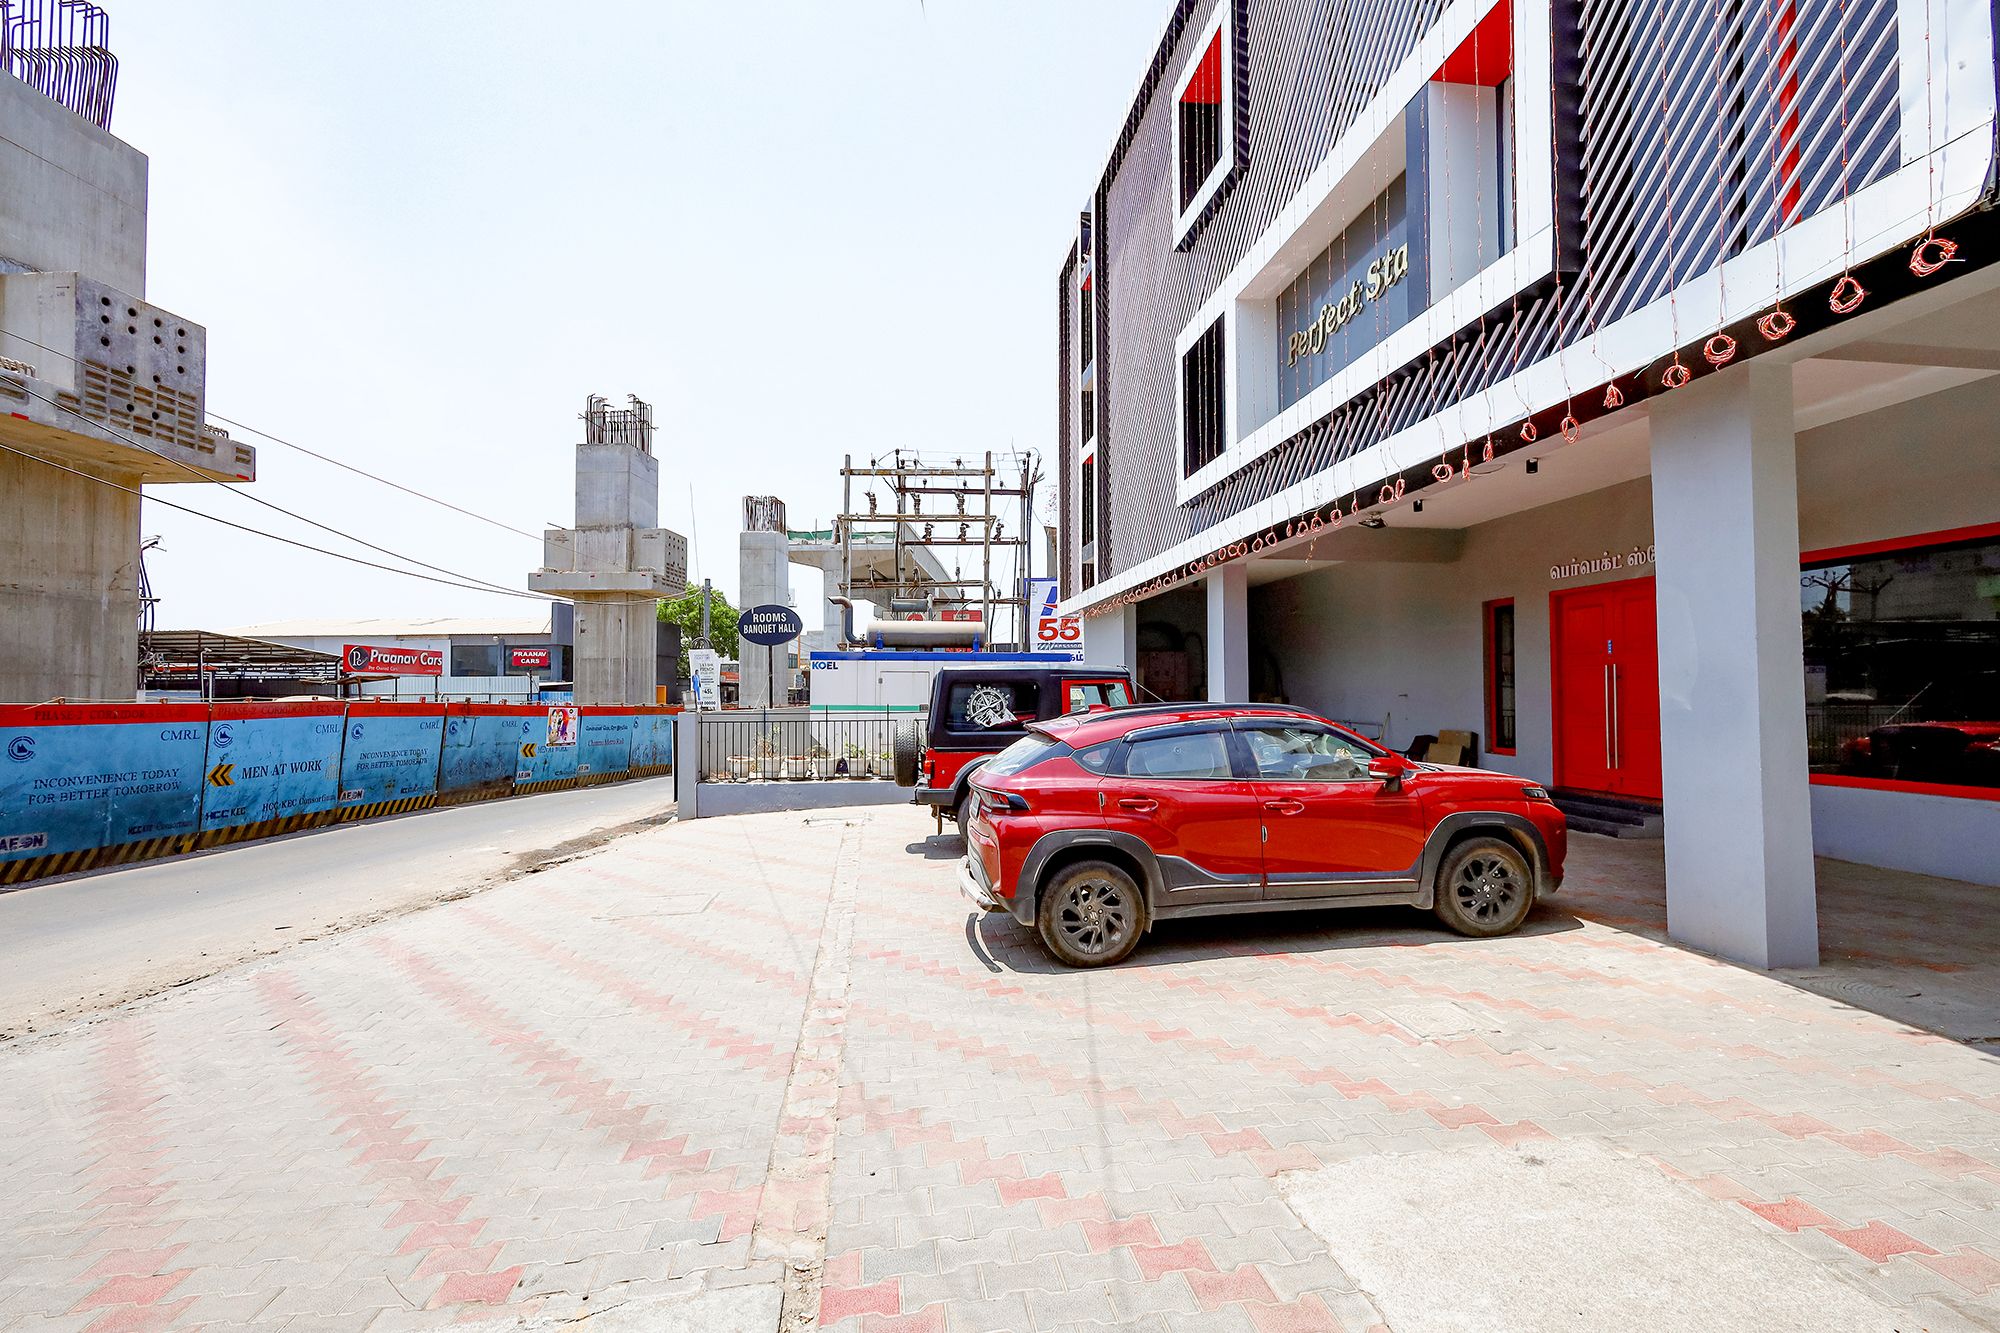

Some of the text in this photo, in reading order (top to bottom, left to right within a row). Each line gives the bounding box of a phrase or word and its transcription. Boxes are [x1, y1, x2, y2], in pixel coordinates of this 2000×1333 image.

[1287, 280, 1365, 368] Perfect
[752, 612, 787, 623] ROOMS
[743, 623, 796, 634] BANQUET HALL
[1037, 618, 1081, 641] 55
[370, 649, 442, 666] Praanav Cars
[811, 661, 839, 670] KOEL
[315, 724, 340, 734] CMRL
[419, 720, 440, 729] CMRL
[160, 729, 201, 741] CMRL
[241, 759, 322, 779] MEN AT WORK
[34, 768, 181, 789] INCONVENIENCE TODAY
[28, 780, 182, 805] FOR BETTER TOMORROW
